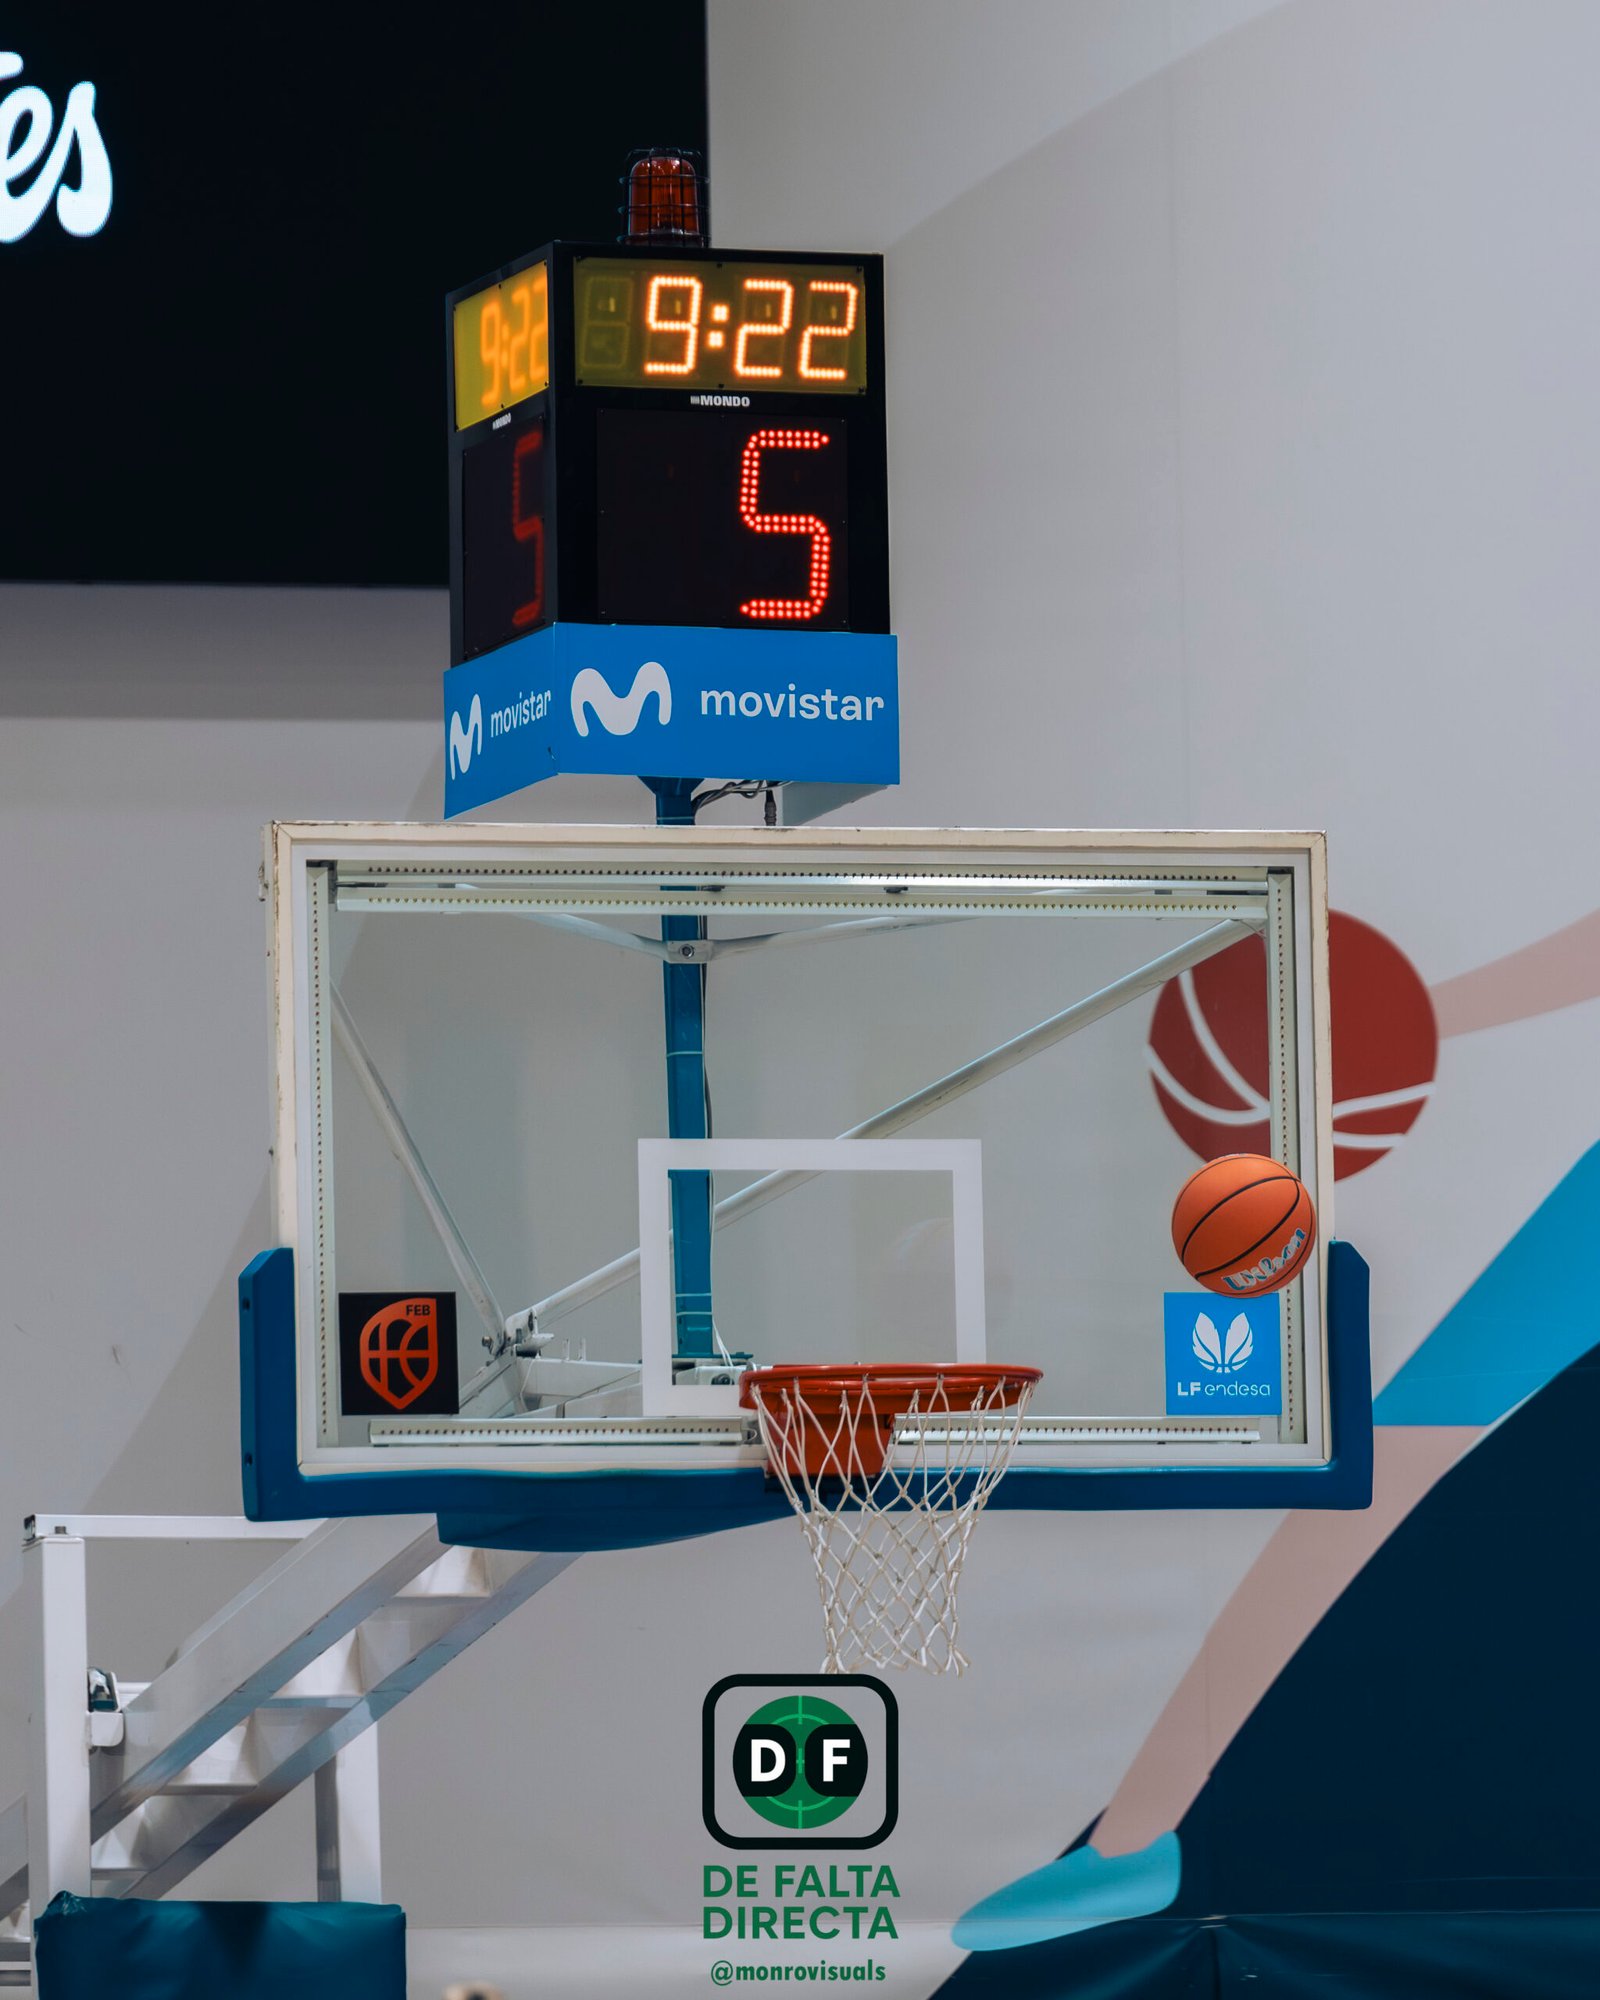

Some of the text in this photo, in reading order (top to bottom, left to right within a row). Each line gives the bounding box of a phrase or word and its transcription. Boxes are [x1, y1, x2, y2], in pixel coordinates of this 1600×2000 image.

[0, 52, 113, 243] es
[480, 274, 548, 406] 9:22
[645, 275, 858, 379] 9:22
[700, 395, 750, 407] MONDO
[513, 432, 543, 626] 5
[739, 430, 832, 619] 5
[490, 689, 551, 738] movistar
[701, 683, 885, 721] movistar
[405, 1304, 431, 1317] FEB
[1177, 1380, 1270, 1396] LF endesa
